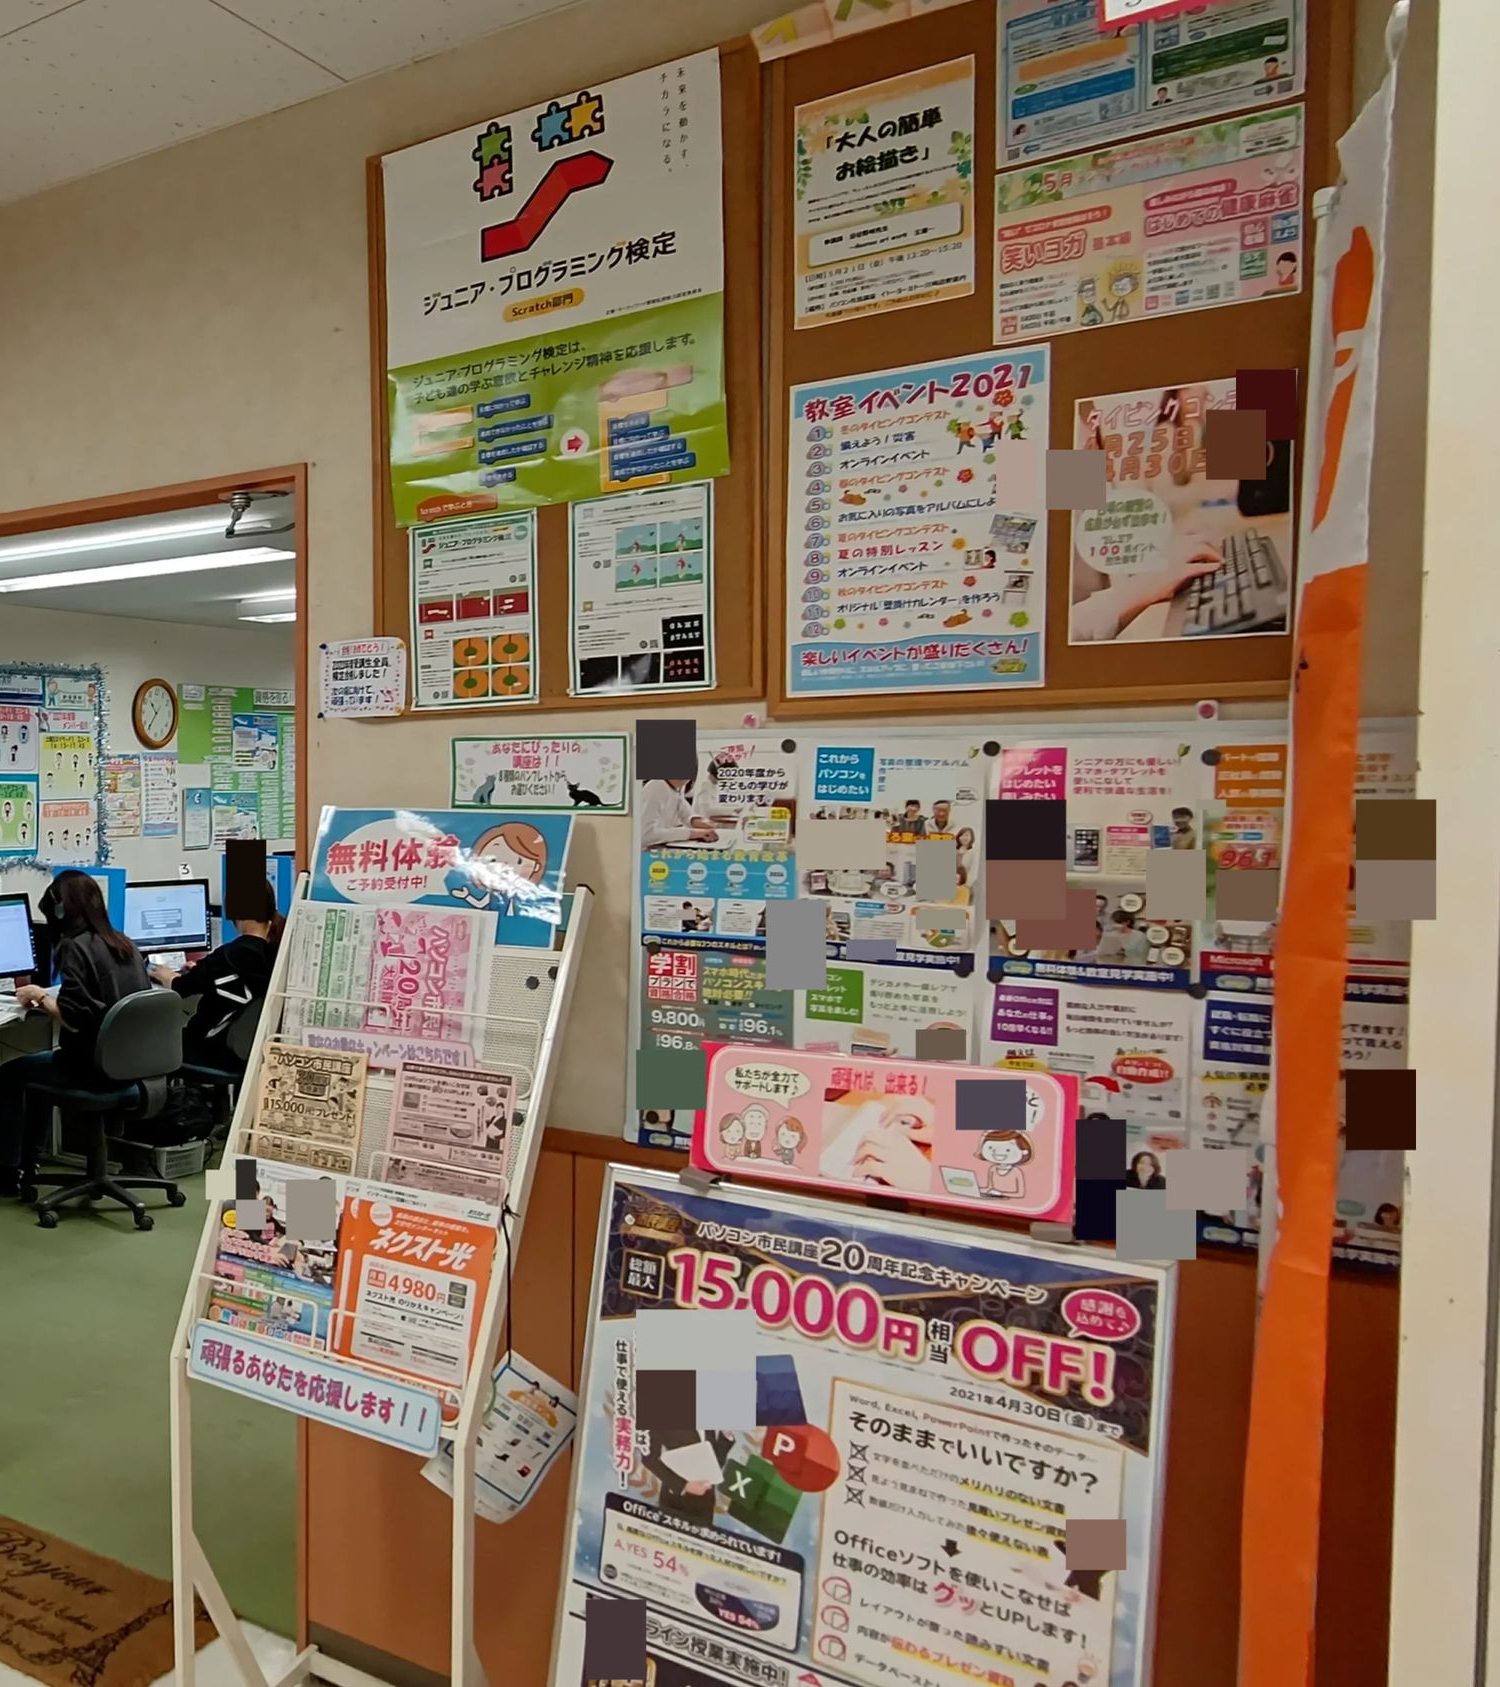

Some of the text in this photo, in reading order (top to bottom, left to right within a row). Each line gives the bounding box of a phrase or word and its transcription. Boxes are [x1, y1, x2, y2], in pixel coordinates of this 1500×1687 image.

[423, 231, 677, 316] ジュニア・プログラミング検定
[512, 292, 575, 318] Scratch部門
[804, 363, 1033, 424] 教室イベント2021
[839, 449, 931, 469] オンラインイベント
[838, 498, 996, 523] お気に入りの写真をアルバムにしよ
[837, 561, 928, 580] オンラインイベント
[669, 619, 701, 630] GAME
[669, 630, 702, 642] START
[802, 640, 1028, 666] 楽しいイベントが盛りだくさん！
[492, 740, 582, 755] あなたにぴったりの
[820, 753, 860, 765] これから
[719, 767, 786, 779] 2020年度から
[719, 781, 788, 791] 子どもの学びが
[817, 783, 870, 795] はじめたい
[719, 793, 773, 804] 変わります。
[326, 834, 461, 876] 無料体験
[180, 863, 190, 875] 3
[346, 875, 428, 891] ご予約受付中！
[649, 953, 697, 977] 学割
[648, 977, 696, 989] プランで
[734, 1067, 801, 1084] 私たちが全力で
[369, 1227, 477, 1271] ネクスト光
[628, 1257, 658, 1276] 総額
[697, 1222, 1047, 1305] パソコン市民講座20周年記念キャンペーン
[627, 1272, 657, 1292] 最大
[930, 1321, 951, 1366] 相当
[961, 1326, 1113, 1405] OFF！
[615, 1340, 634, 1489] 仕事で使える実務力！
[949, 1386, 1123, 1438] 2021年4月30日（金）まで
[773, 1433, 796, 1457] P
[849, 1411, 1099, 1495] そのままでいいですか？
[729, 1471, 753, 1500] X
[833, 1551, 1088, 1649] 仕事の効率は グッとUPします！
[646, 1618, 790, 1686] ライン授業実施中！
